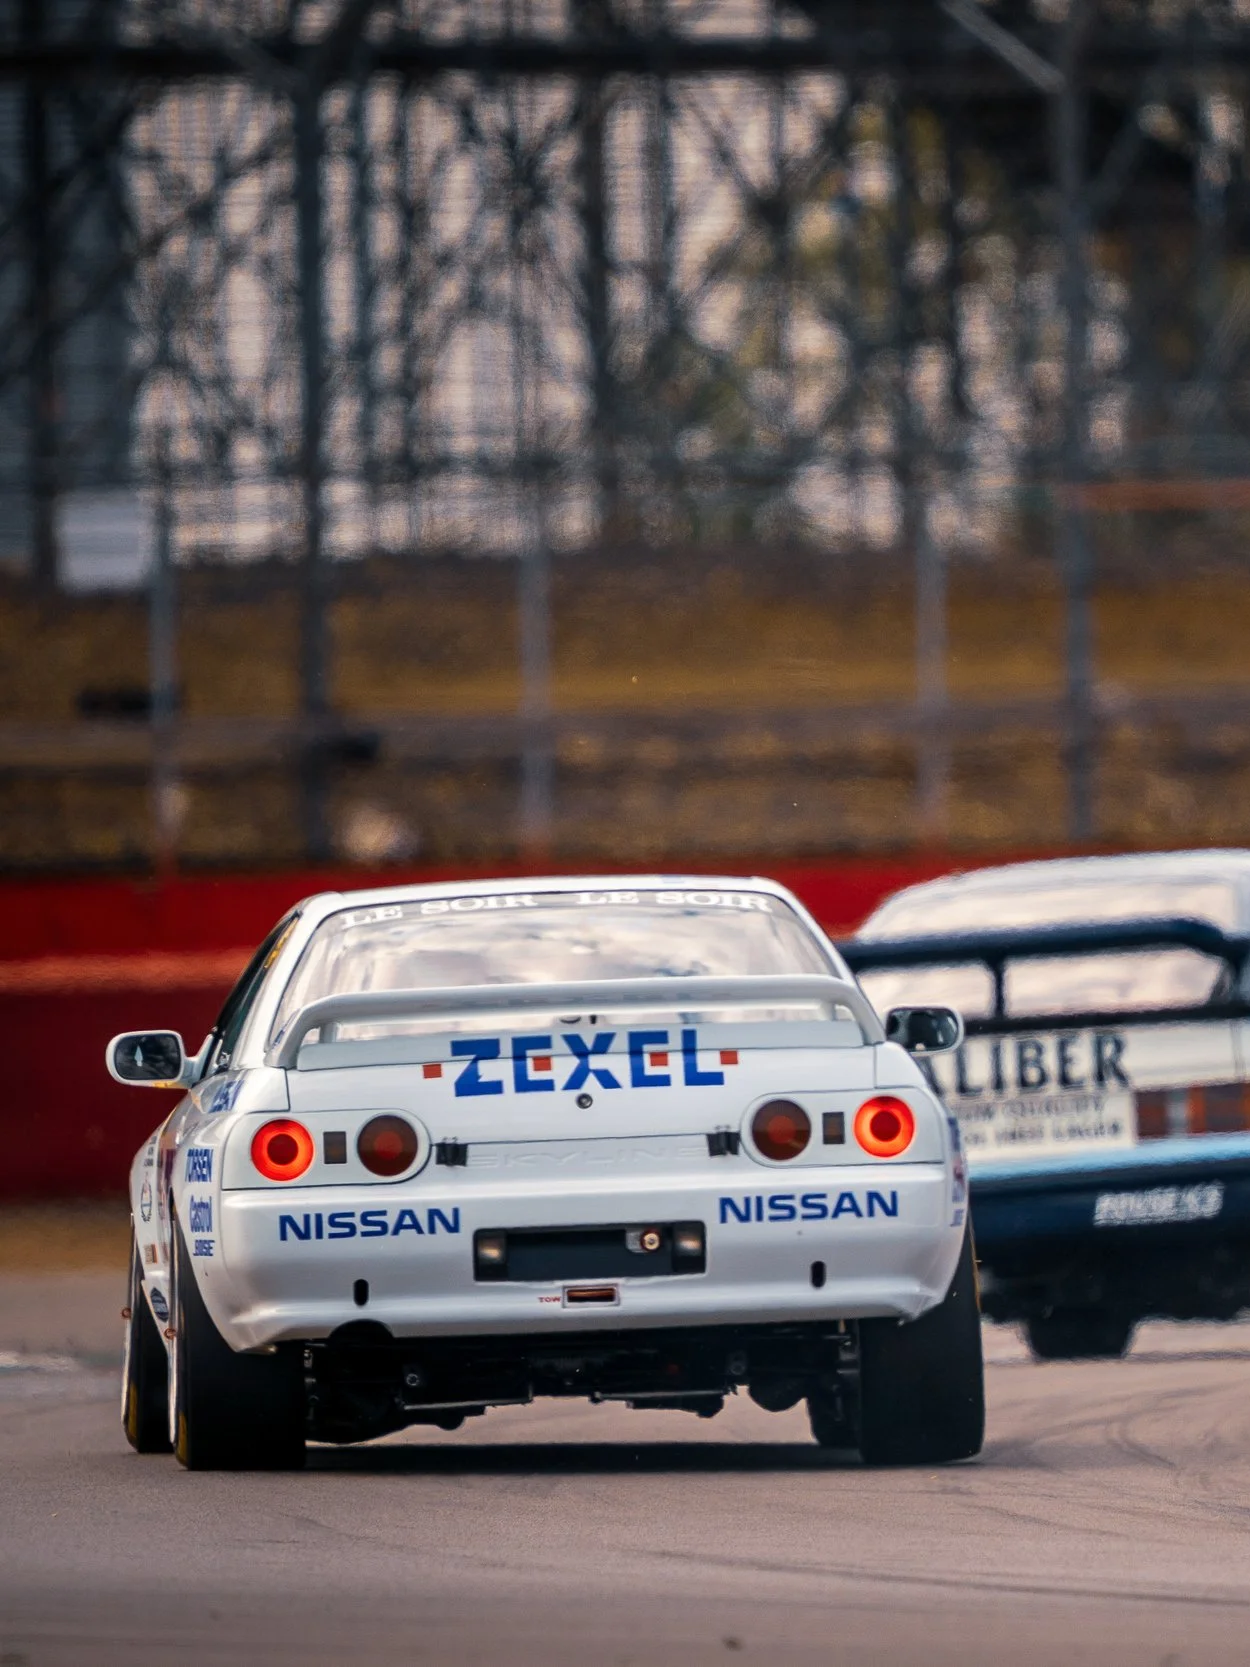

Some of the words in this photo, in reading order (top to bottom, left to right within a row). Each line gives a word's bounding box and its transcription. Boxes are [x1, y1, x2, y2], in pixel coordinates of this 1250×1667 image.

[341, 905, 404, 929] LE
[420, 893, 539, 915] SOIR
[576, 891, 640, 906] LE
[656, 891, 773, 913] SOIR
[450, 1028, 725, 1098] ZEXEL
[279, 1206, 461, 1242] NISSAN
[718, 1189, 899, 1225] NISSAN
[538, 1296, 561, 1304] TOW
